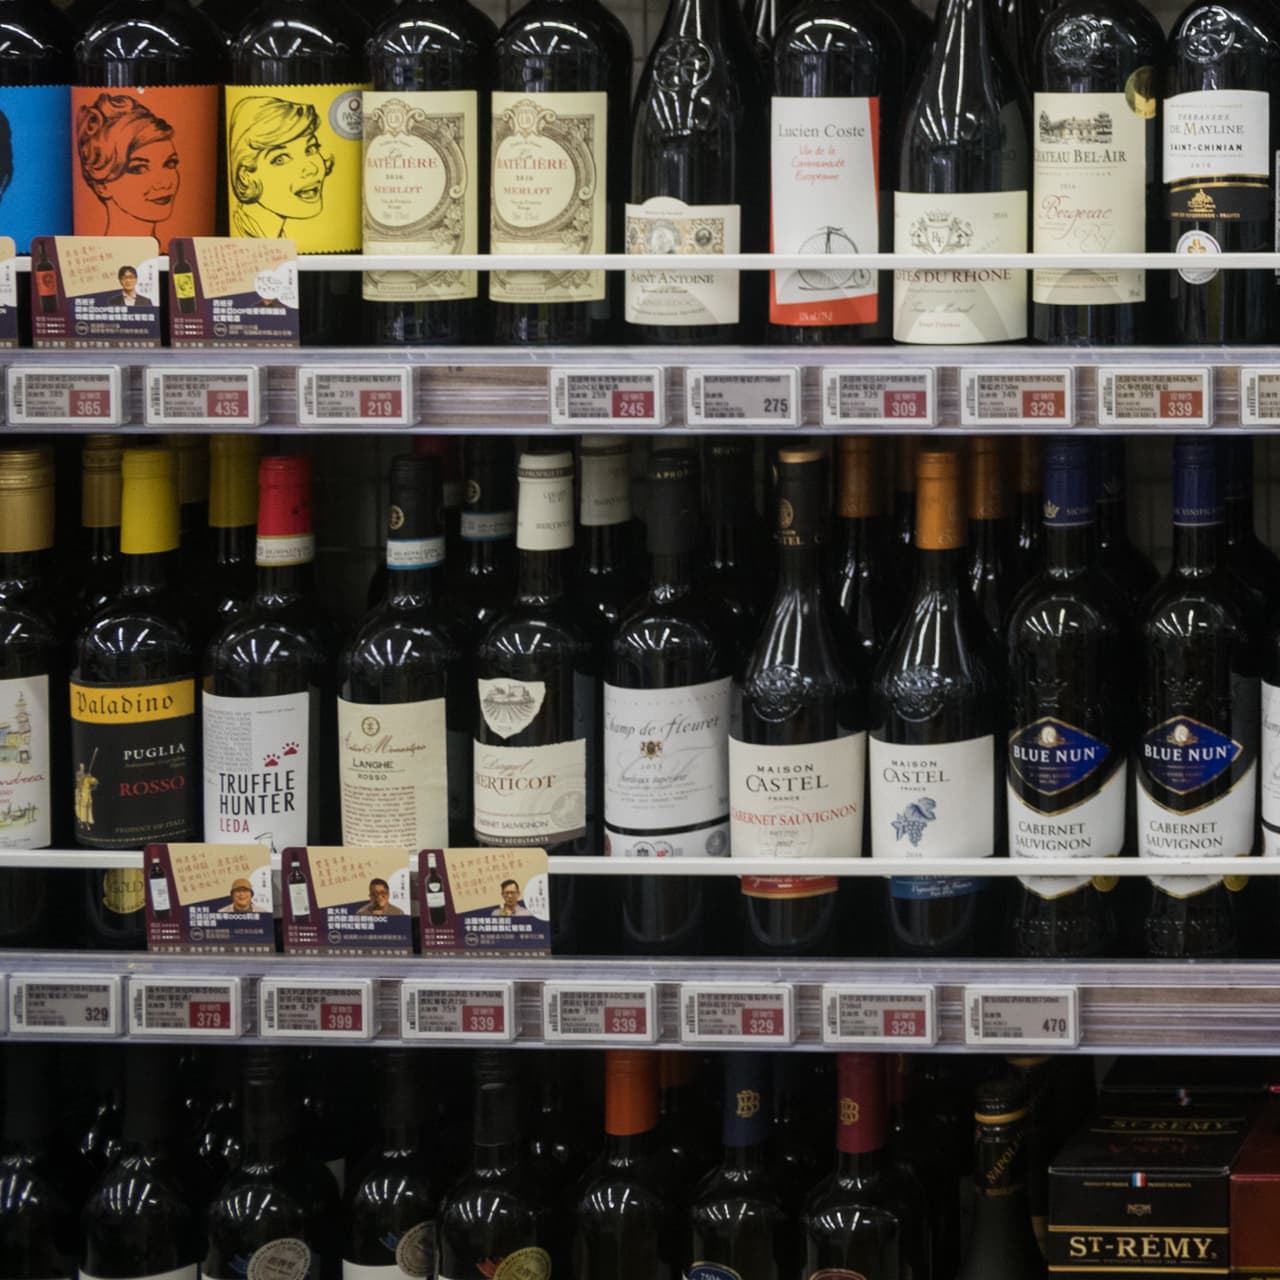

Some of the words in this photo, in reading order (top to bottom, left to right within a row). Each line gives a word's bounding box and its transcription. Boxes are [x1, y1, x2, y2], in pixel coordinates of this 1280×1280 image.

[778, 123, 819, 138] Lucien
[823, 124, 866, 138] Coste
[1169, 124, 1180, 135] DE
[1183, 120, 1244, 136] MAYLINE
[1169, 143, 1243, 153] SAINT-CHINIAN
[215, 401, 239, 415] 435
[764, 398, 788, 413] 275
[1167, 402, 1192, 416] 339
[123, 743, 186, 760] PUGLIA
[1013, 746, 1051, 763] BLUE
[1056, 747, 1095, 763] NUN
[352, 758, 395, 770] LANGHE
[757, 763, 814, 774] MAISON
[891, 759, 937, 768] MAISON
[219, 770, 295, 793] TRUFFLE
[357, 773, 387, 781] ROSSO
[746, 772, 828, 792] CASTEL
[883, 767, 950, 783] CASTEL
[119, 775, 185, 797] ROSSO
[219, 791, 295, 816] HUNTER
[779, 802, 858, 826] SAUVIGNON
[220, 817, 250, 833] LEDA
[1018, 822, 1085, 835] CABERNET
[1149, 821, 1216, 835] CABERNET
[1015, 836, 1092, 851] SAUVIGNON
[1146, 835, 1224, 851] SAUVIGNON
[197, 1013, 221, 1027] 379
[612, 1018, 637, 1031] 339
[1042, 1018, 1067, 1033] 470
